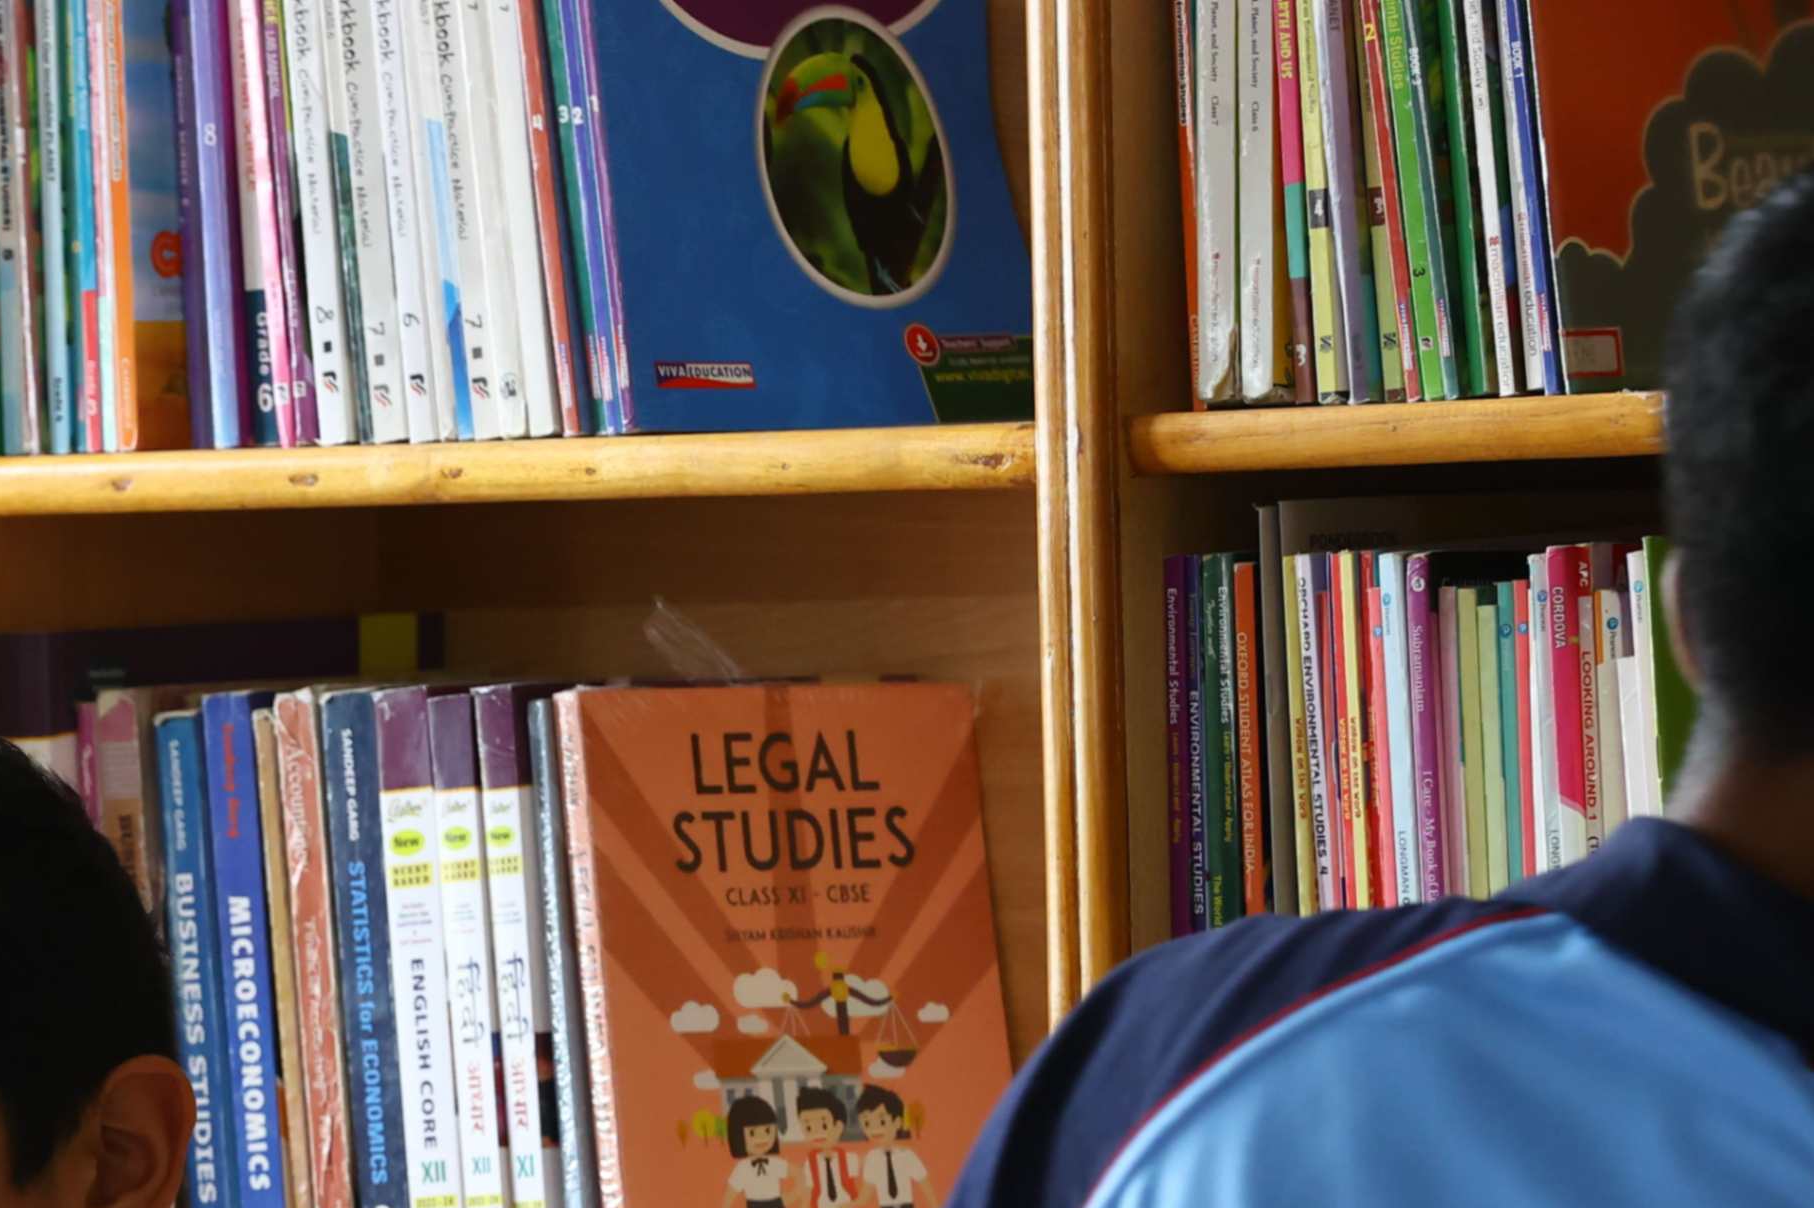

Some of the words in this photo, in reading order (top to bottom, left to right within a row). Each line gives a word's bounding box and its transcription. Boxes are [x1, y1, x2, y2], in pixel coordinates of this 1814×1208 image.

[1210, 33, 1218, 49] and
[1278, 31, 1292, 58] AND
[1365, 22, 1377, 42] 2
[1208, 51, 1219, 82] Society
[1249, 57, 1259, 88] Society
[1280, 61, 1293, 79] US
[1389, 35, 1406, 90] Studies
[1408, 46, 1420, 76] BOOK
[1471, 46, 1484, 88] Society
[1510, 40, 1523, 68] BOOK
[557, 105, 569, 124] 3
[571, 106, 584, 125] 2
[590, 95, 600, 113] 1
[1210, 95, 1219, 118] Class
[1250, 101, 1259, 124] Class
[1413, 268, 1426, 278] 3
[1489, 247, 1505, 318] macmillan
[1521, 289, 1540, 356] education
[255, 312, 270, 377] Grade
[657, 365, 686, 377] VIVA
[687, 364, 752, 379] EDUCATION
[1578, 561, 1589, 587] APC
[1165, 587, 1179, 675] Environmental
[1215, 585, 1230, 674] Environmental
[1547, 585, 1569, 649] CORDOVA
[1234, 631, 1249, 689] OXFORD
[1167, 679, 1179, 724] Studies
[1217, 678, 1231, 723] Studies
[1581, 651, 1594, 729] LOOKING
[1237, 693, 1251, 753] STUDENT
[1300, 655, 1322, 786] ENVIRONMENTAL
[165, 738, 186, 806] SANDEEP
[339, 727, 356, 796] SANDEEP
[690, 729, 882, 796] LEGAL
[1188, 690, 1203, 832] ENVIRONMENTAL
[1239, 758, 1253, 798] ATLAS
[1583, 734, 1597, 807] AROUND
[1422, 778, 1434, 807] Care
[171, 808, 188, 851] GARG
[345, 798, 359, 841] GARG
[1241, 802, 1254, 832] FOR
[1311, 793, 1328, 858] STUDIES
[1422, 817, 1436, 838] My
[393, 837, 420, 848] New
[672, 806, 916, 874] STUDIES
[1242, 833, 1255, 872] INDIA
[1425, 839, 1437, 867] Book
[393, 863, 429, 876] NCERT
[1191, 841, 1205, 915] STUDIES
[1318, 865, 1329, 876] 4
[1396, 830, 1410, 893] LONGMAN
[1426, 870, 1439, 886] of
[725, 885, 781, 907] CLASS
[788, 885, 808, 905] XI
[826, 882, 871, 904] CBSE
[1211, 875, 1223, 893] The
[346, 859, 374, 994] STATISTICS
[1211, 895, 1224, 926] World
[169, 871, 210, 1046] BUSINESS
[358, 1000, 377, 1032] for
[407, 957, 433, 1070] ENGLISH
[224, 894, 278, 1191] MICROECONOMICS
[185, 1054, 220, 1204] STUDIES
[360, 1038, 389, 1185] ECONOMICS
[418, 1079, 438, 1149] CORE
[421, 1160, 447, 1183] XII
[471, 1156, 492, 1175] XII
[516, 1154, 535, 1178] XI
